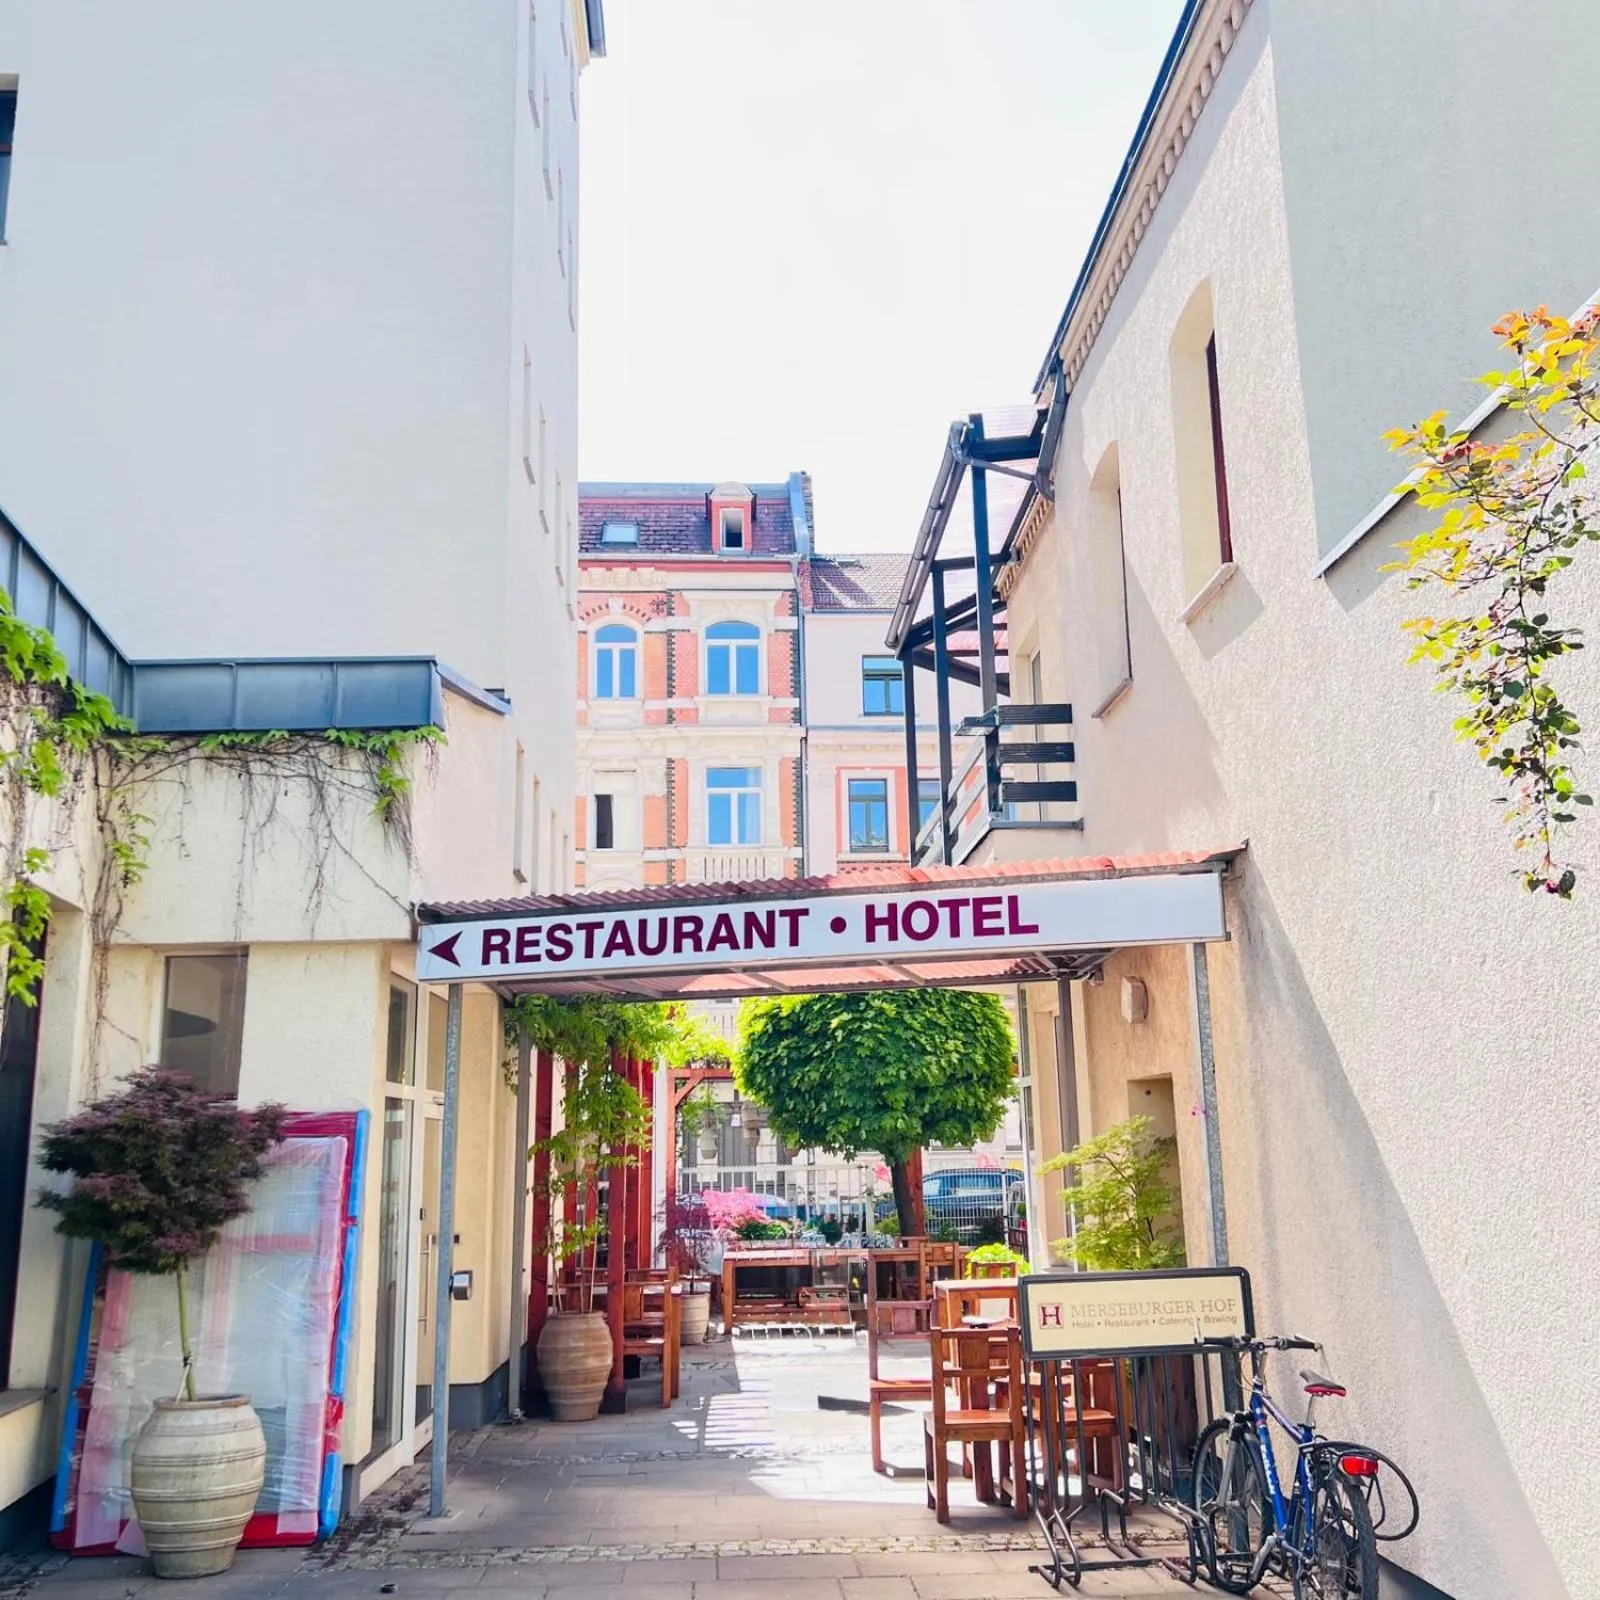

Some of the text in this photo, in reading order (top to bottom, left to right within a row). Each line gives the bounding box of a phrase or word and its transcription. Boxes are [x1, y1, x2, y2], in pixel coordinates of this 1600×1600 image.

[482, 895, 1039, 966] RESTAURANT HOTEL
[1041, 1305, 1061, 1325] H
[1071, 1298, 1236, 1318] MERSEBURGER HOF
[1072, 1314, 1237, 1328] Hotel Restaurant Catering Bowling
